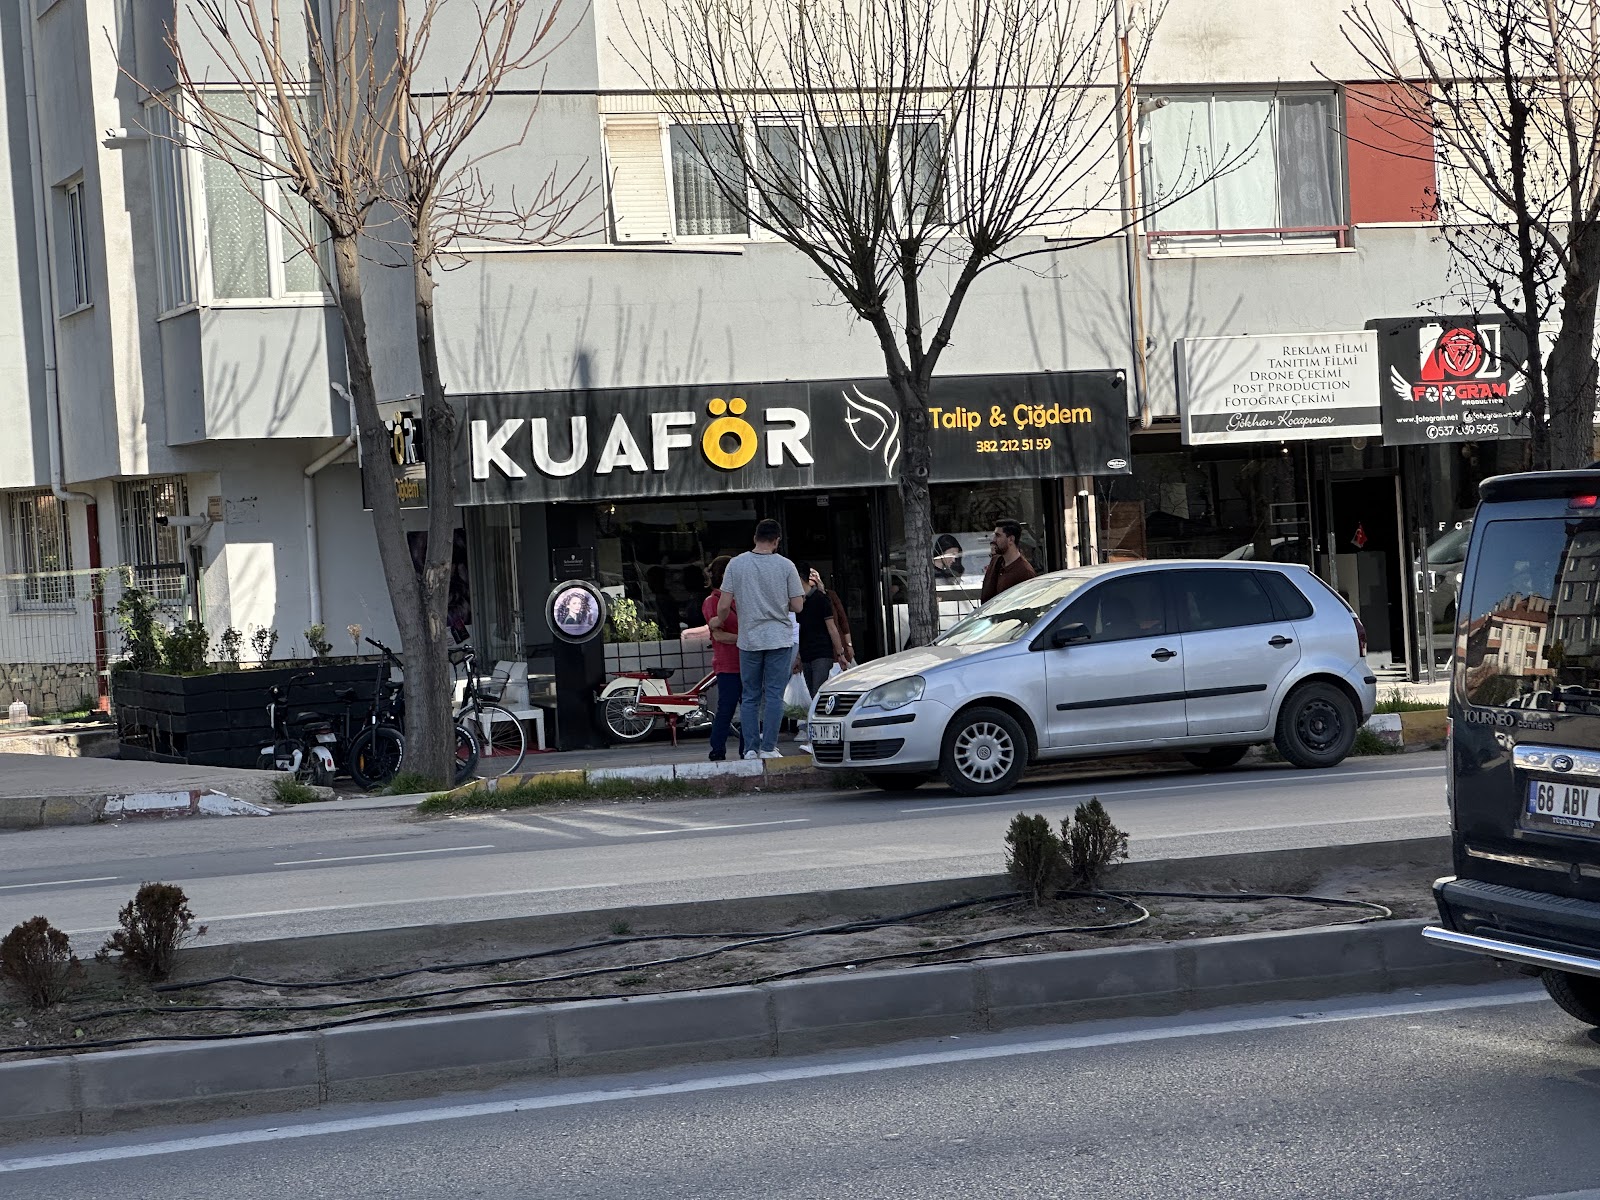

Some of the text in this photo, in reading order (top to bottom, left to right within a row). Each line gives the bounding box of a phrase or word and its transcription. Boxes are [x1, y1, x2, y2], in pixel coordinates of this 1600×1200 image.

[1283, 342, 1368, 356] REKLAM FİLMİ
[1267, 355, 1357, 368] TANITIM FİLMİ
[1250, 367, 1341, 381] DRONE ÇEKİMİ
[1233, 380, 1350, 394] POST PRODUCTION
[1225, 392, 1335, 407] FOTOĞRAF ÇEKİMİ
[928, 402, 1092, 432] Talip & Çiğdem
[1226, 412, 1275, 432] Gökhan
[1396, 413, 1459, 424] www.fotogram.net
[1438, 426, 1454, 437] 537
[1476, 424, 1499, 434] 5995
[471, 398, 814, 480] KUAFÖR
[976, 437, 1051, 453] 382 212 51 59
[1463, 709, 1554, 732] TOURNEO connect
[1538, 784, 1554, 812] 68
[1562, 787, 1589, 817] ABV
